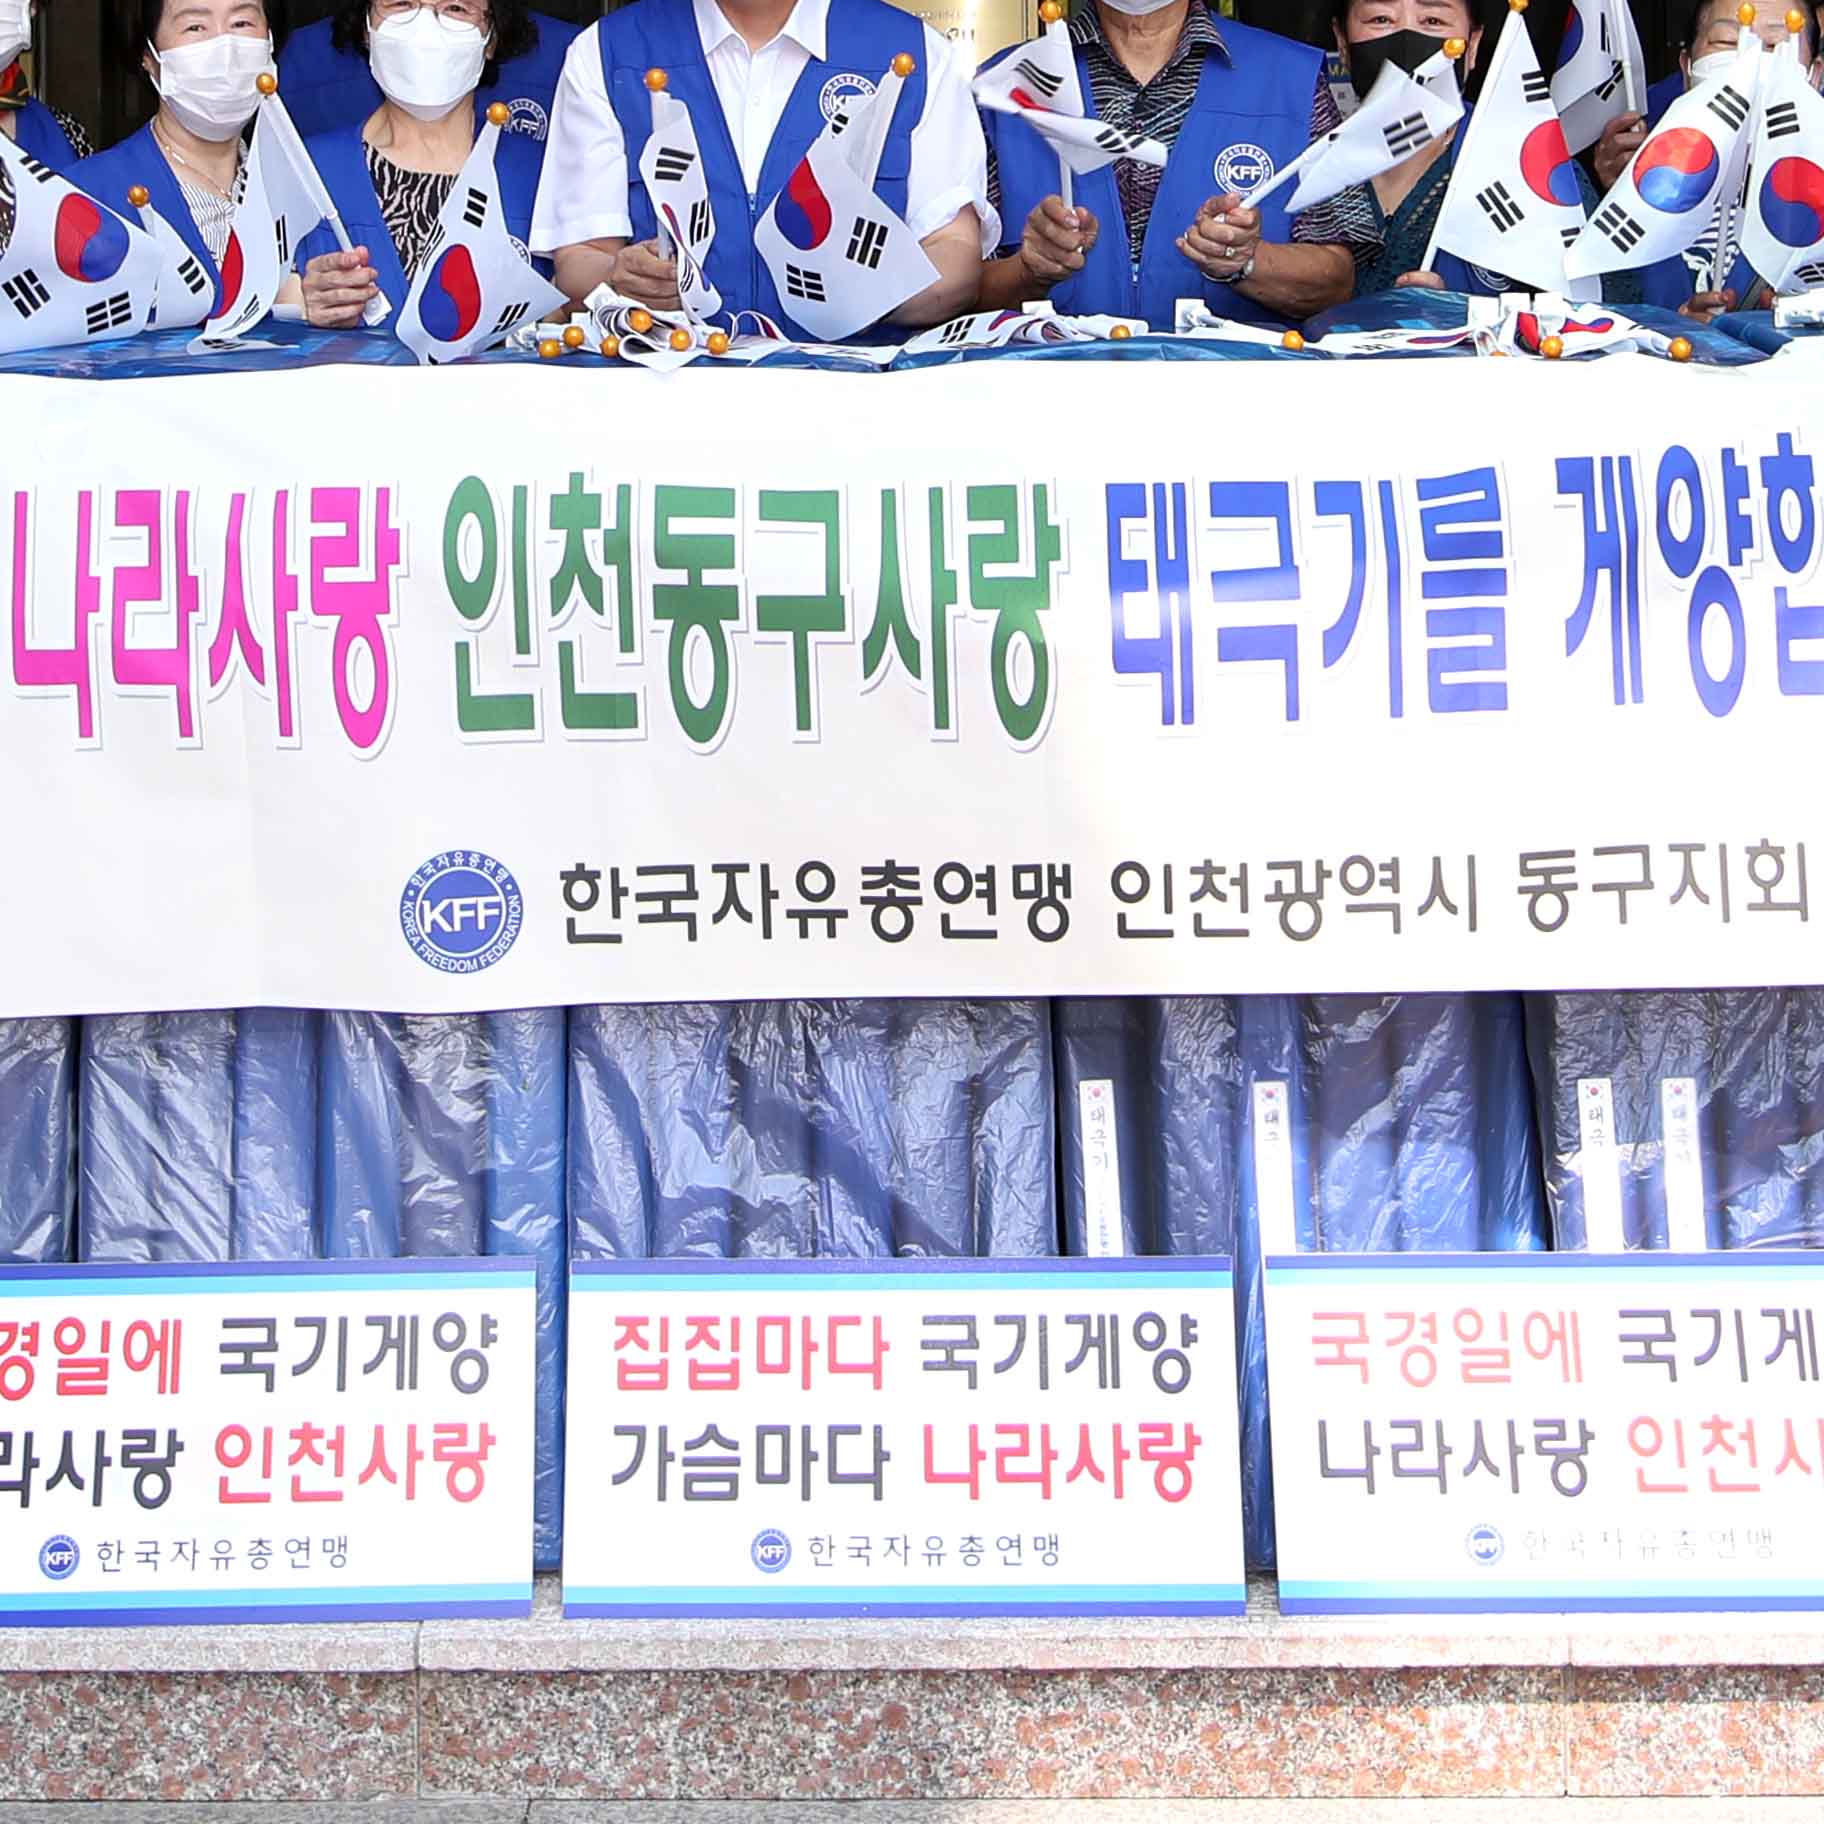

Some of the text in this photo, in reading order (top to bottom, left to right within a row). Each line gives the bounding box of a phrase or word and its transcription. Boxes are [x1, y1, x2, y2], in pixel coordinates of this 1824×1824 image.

[1227, 164, 1262, 181] KFF
[13, 487, 400, 748] 나라사랑
[443, 472, 1061, 744] 인천동구사랑
[1106, 466, 1507, 725] 태극기를
[411, 850, 510, 889] 한국자유총연맹
[560, 838, 1808, 944] 한국자유총연맹 인천광역시 동구지회
[401, 893, 522, 972] KOREA FREEDOM FEDERATION
[421, 895, 503, 935] KFF
[1089, 1105, 1109, 1169] 태극기
[219, 1312, 498, 1394] 국기게양
[614, 1311, 1198, 1394] 집집마다 국기게양
[1312, 1308, 1582, 1387] 국경일에
[215, 1422, 496, 1504] 인천사랑
[612, 1423, 1202, 1503] 가슴마다 나라사랑
[1318, 1419, 1595, 1497] 나라사랑
[97, 1536, 347, 1573] 한국자유총연맹
[808, 1533, 1059, 1567] 한국자유총연맹
